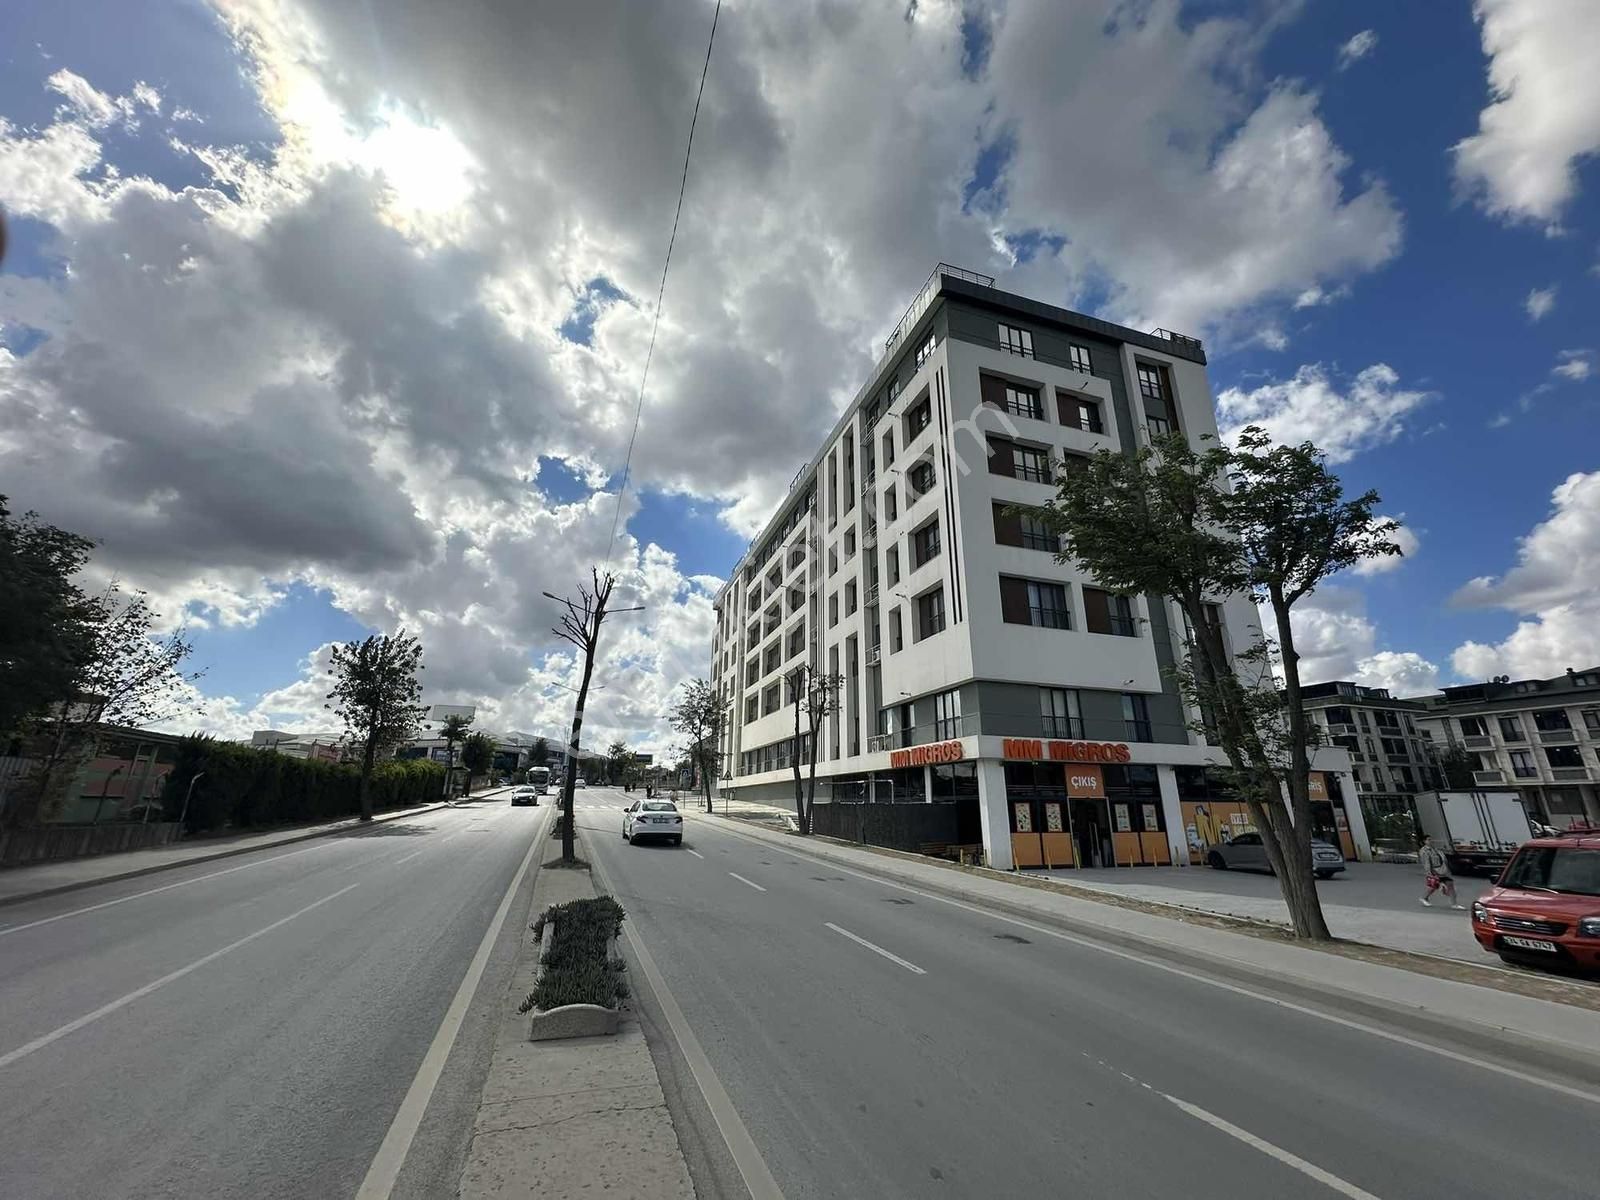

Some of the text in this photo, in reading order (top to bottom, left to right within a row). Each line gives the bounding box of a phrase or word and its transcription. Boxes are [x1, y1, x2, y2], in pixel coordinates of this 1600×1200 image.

[1003, 739, 1043, 760] MM
[890, 750, 910, 768] MM
[1071, 776, 1097, 790] ÇIKIŞ
